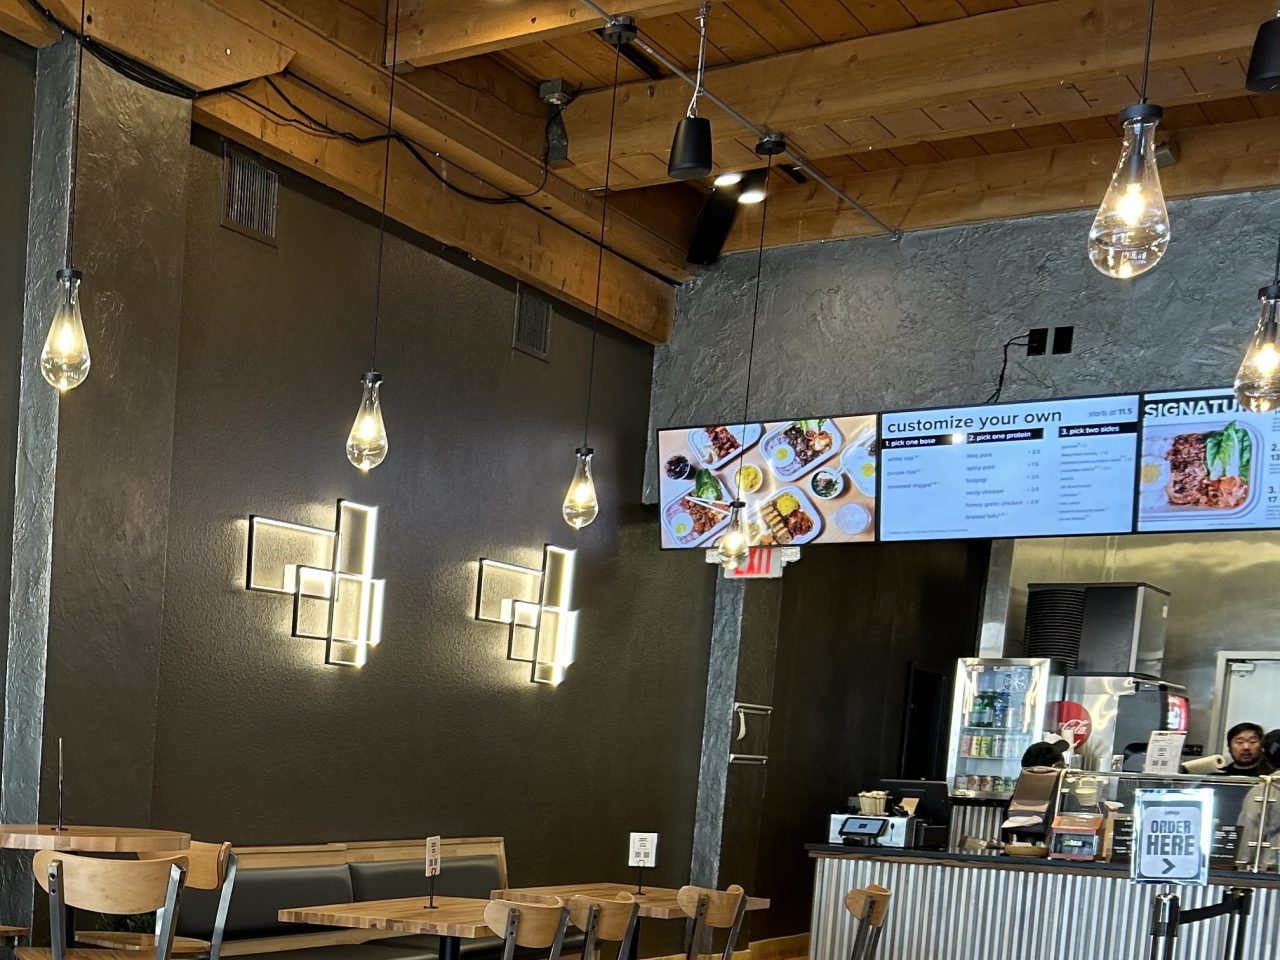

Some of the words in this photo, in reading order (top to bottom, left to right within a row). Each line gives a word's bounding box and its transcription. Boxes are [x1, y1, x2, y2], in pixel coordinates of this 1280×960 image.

[887, 415, 974, 433] customize
[979, 413, 1019, 430] your
[1024, 411, 1062, 424] own
[976, 434, 991, 442] pick
[1006, 431, 1031, 440] protein
[1069, 427, 1085, 436] pick
[1100, 425, 1120, 433] sides
[890, 439, 905, 448] pick
[919, 437, 936, 445] base
[1151, 820, 1192, 834] ORDER
[1146, 834, 1195, 856] HERE
